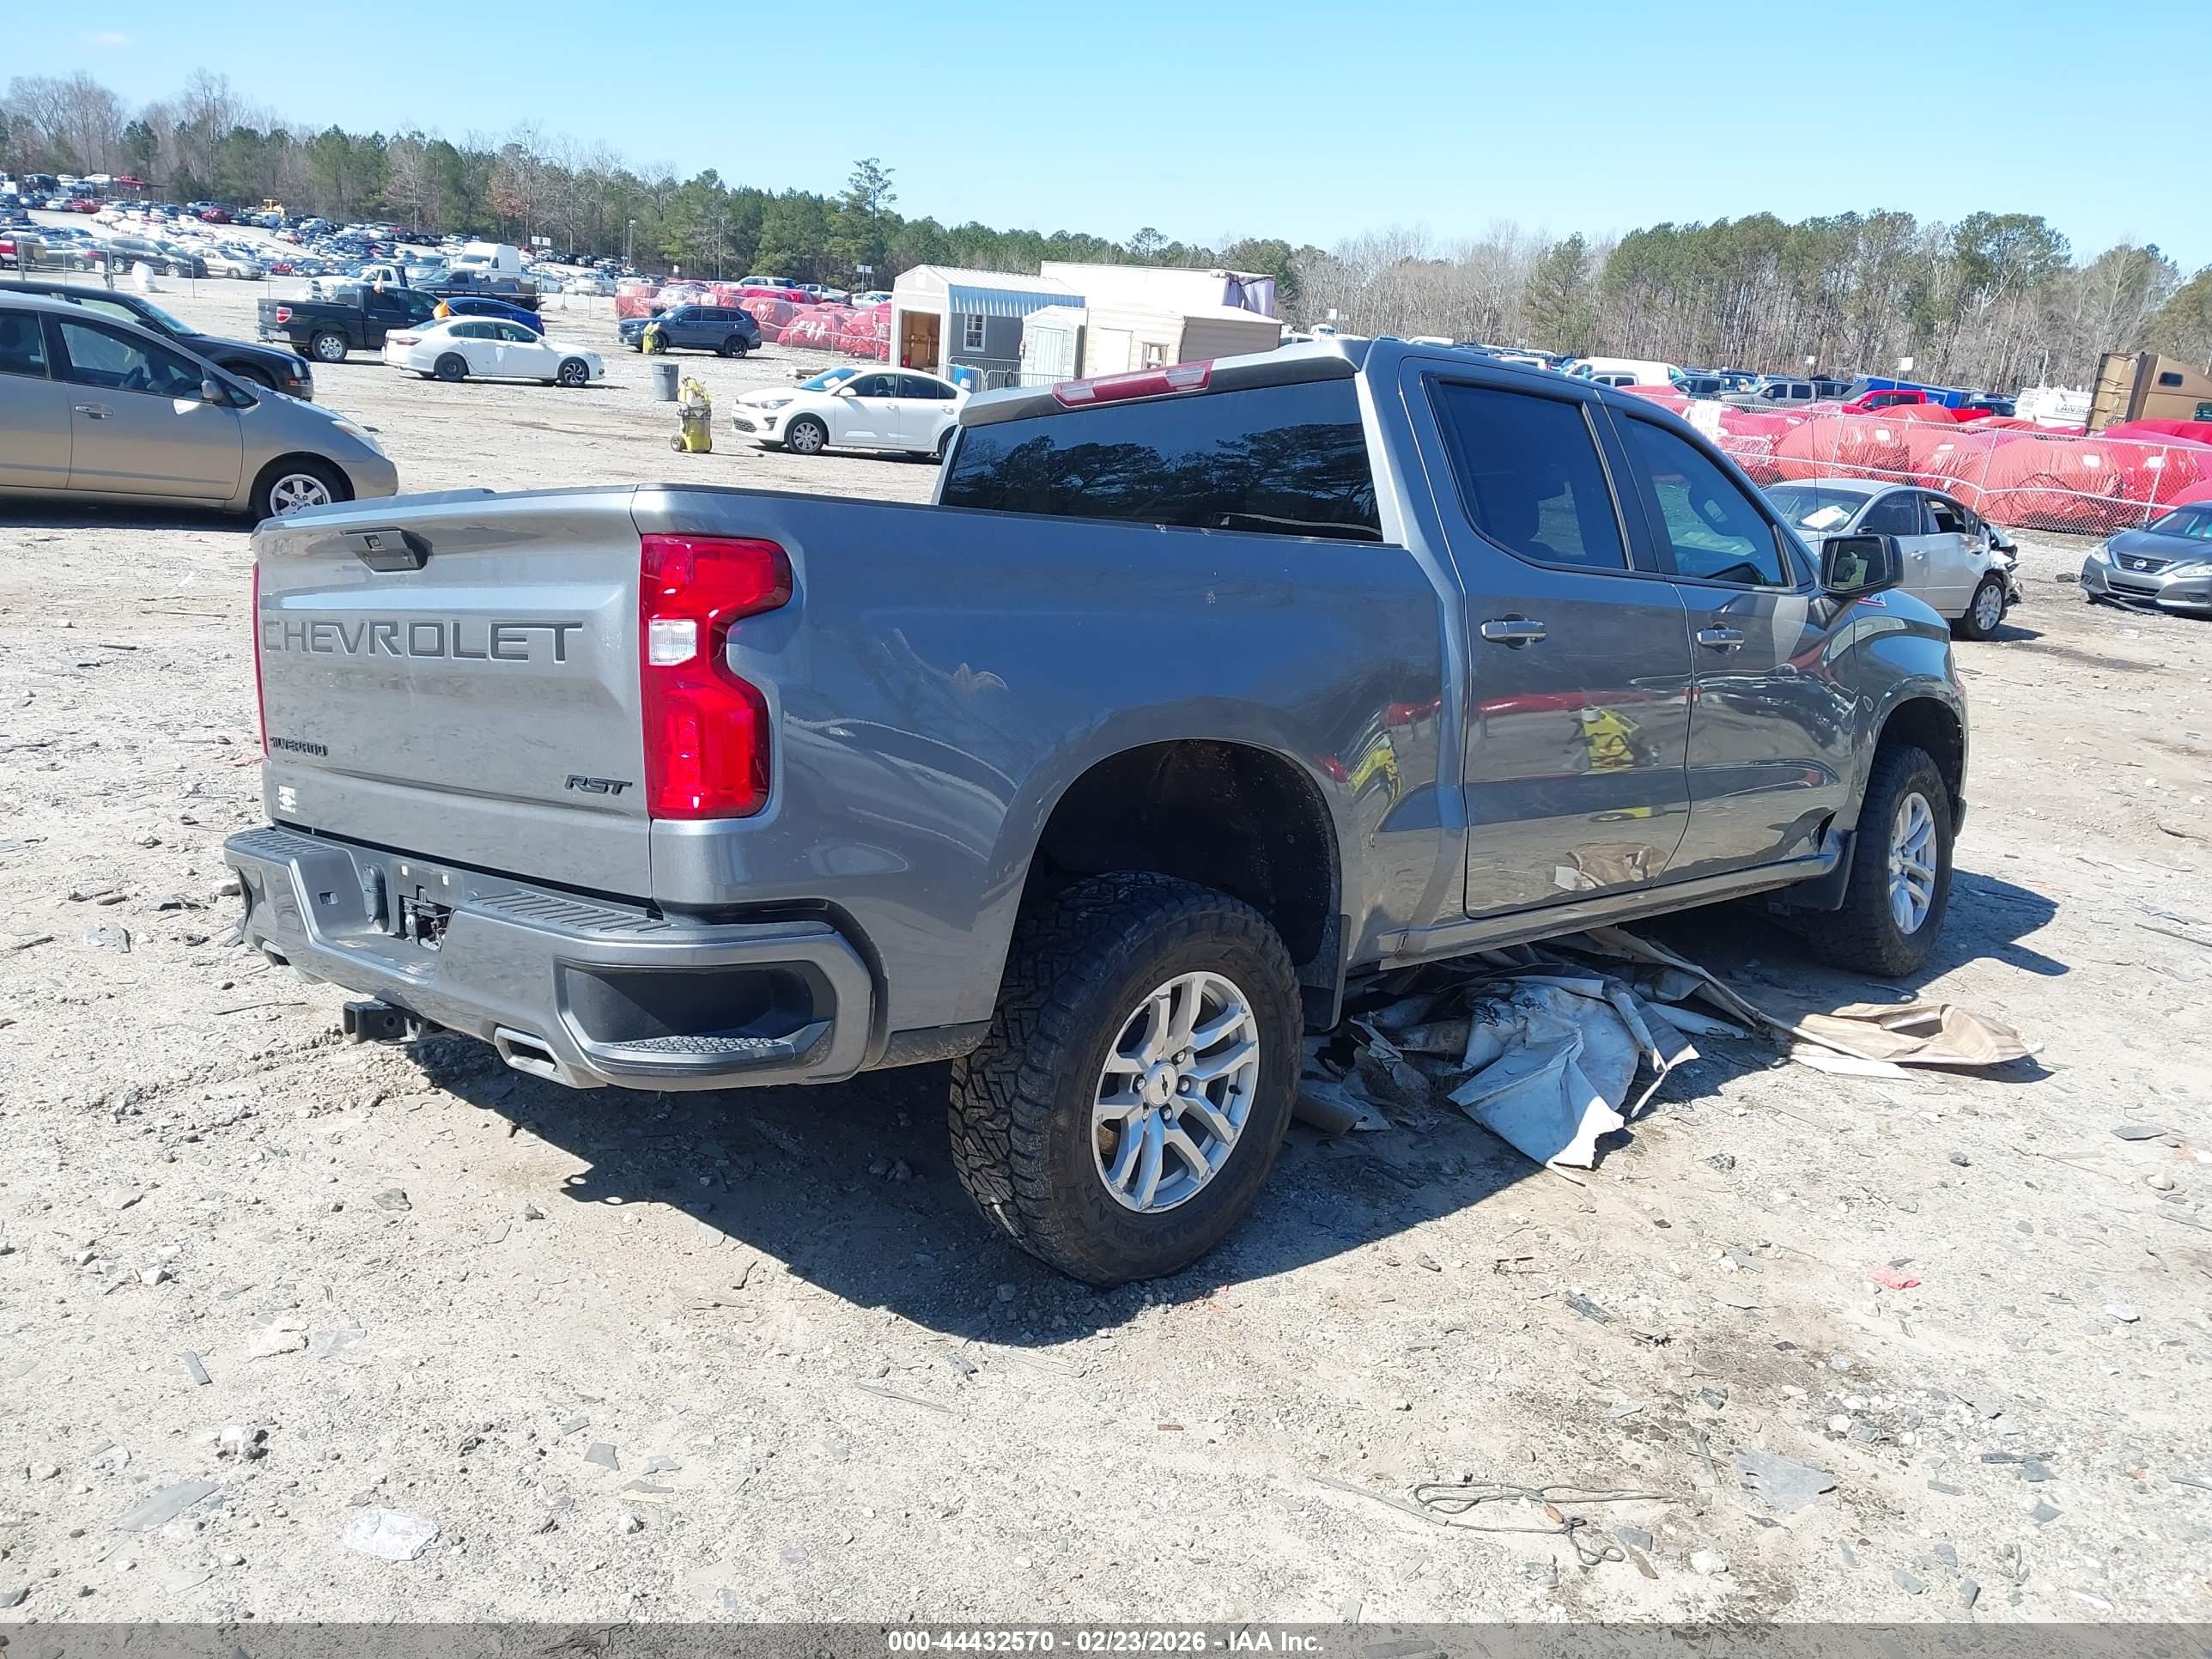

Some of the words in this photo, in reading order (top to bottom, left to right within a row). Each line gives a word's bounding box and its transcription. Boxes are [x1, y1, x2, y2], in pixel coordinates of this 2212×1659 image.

[262, 620, 584, 665] CHEVROLET
[269, 736, 329, 757] SILVERADO
[564, 774, 633, 797] RST
